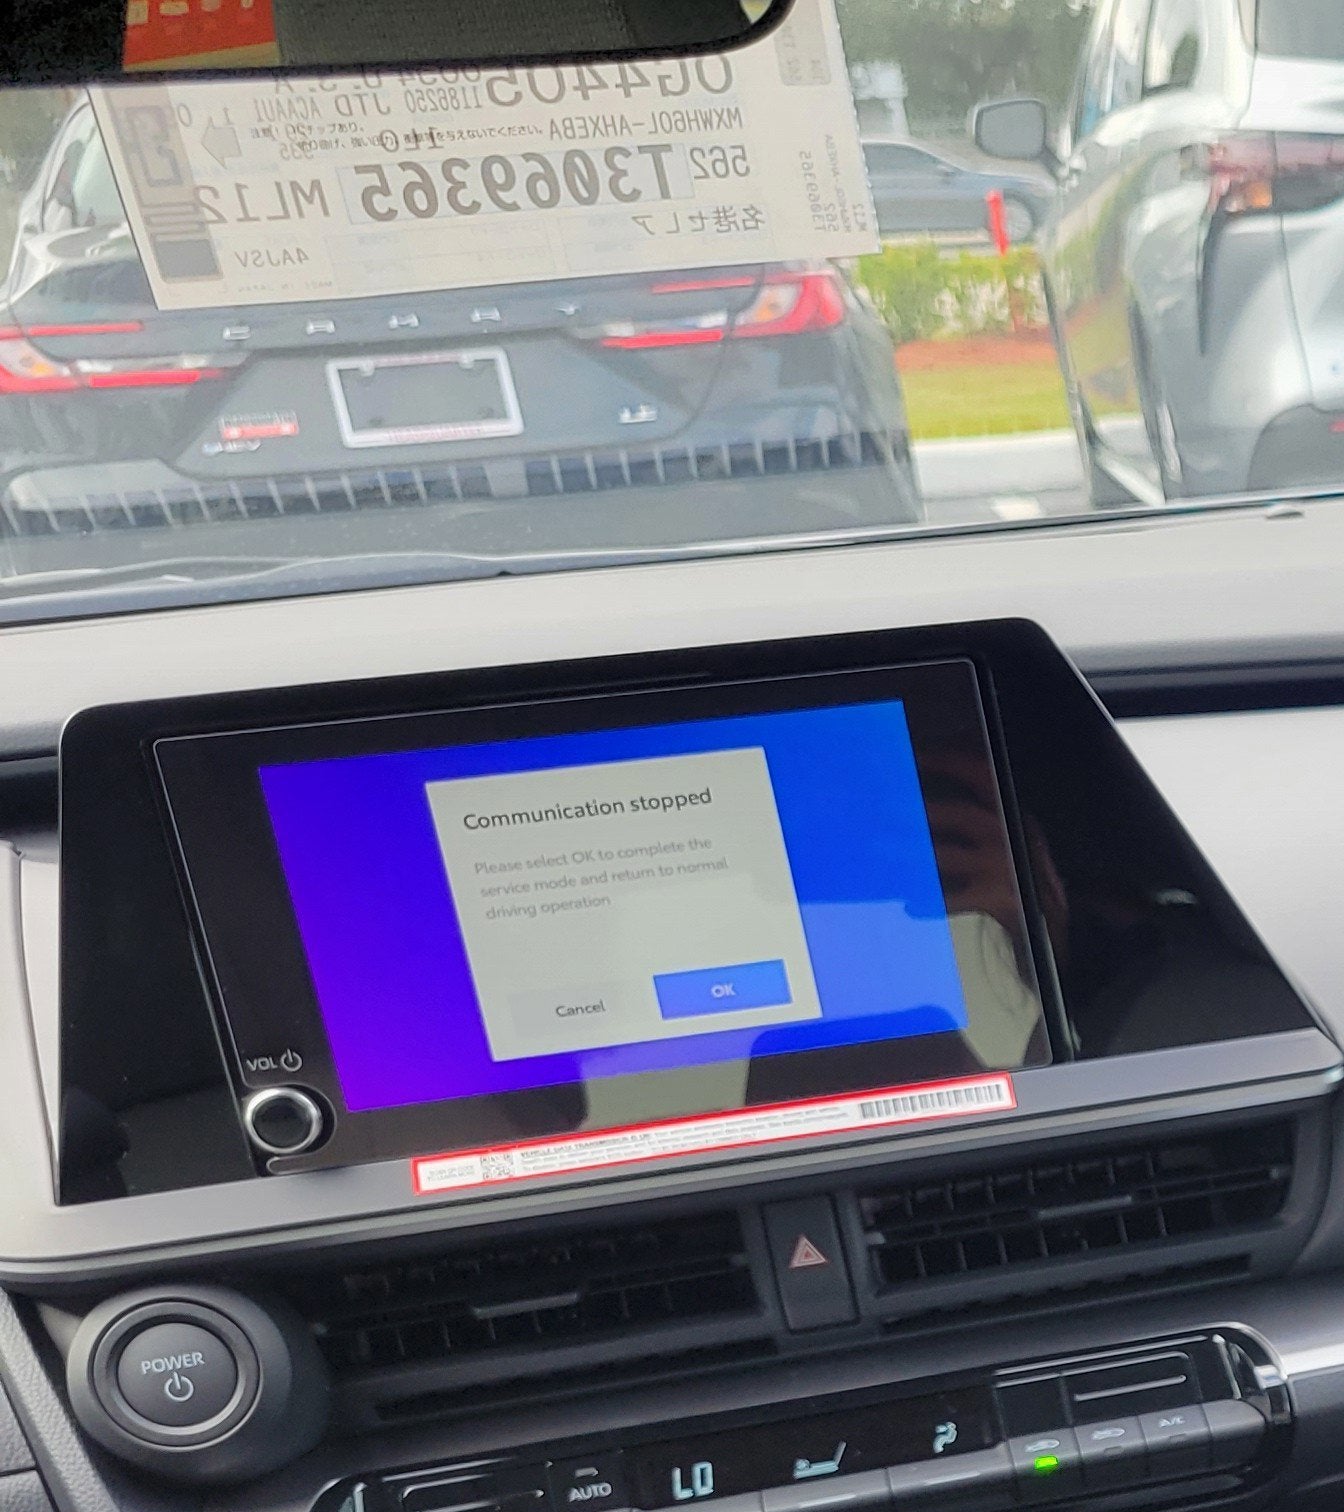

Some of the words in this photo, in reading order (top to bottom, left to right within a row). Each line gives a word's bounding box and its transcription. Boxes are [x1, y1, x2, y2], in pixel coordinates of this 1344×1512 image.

[463, 799, 625, 830] Communication
[630, 787, 712, 813] stopped
[474, 857, 523, 874] Please
[526, 852, 568, 870] select
[571, 849, 596, 864] OK
[599, 848, 614, 862] to
[617, 841, 686, 862] complete
[689, 836, 712, 851] the
[481, 881, 530, 898] service
[534, 873, 576, 891] mode
[580, 869, 608, 886] and
[611, 865, 655, 883] return
[658, 863, 673, 877] to
[677, 855, 729, 875] normal
[486, 901, 537, 921] driving
[711, 983, 737, 998] OK
[556, 999, 606, 1017] Cancel
[246, 1057, 278, 1071] VOL
[141, 1352, 205, 1375] POWER
[568, 1482, 613, 1502] AUTO
